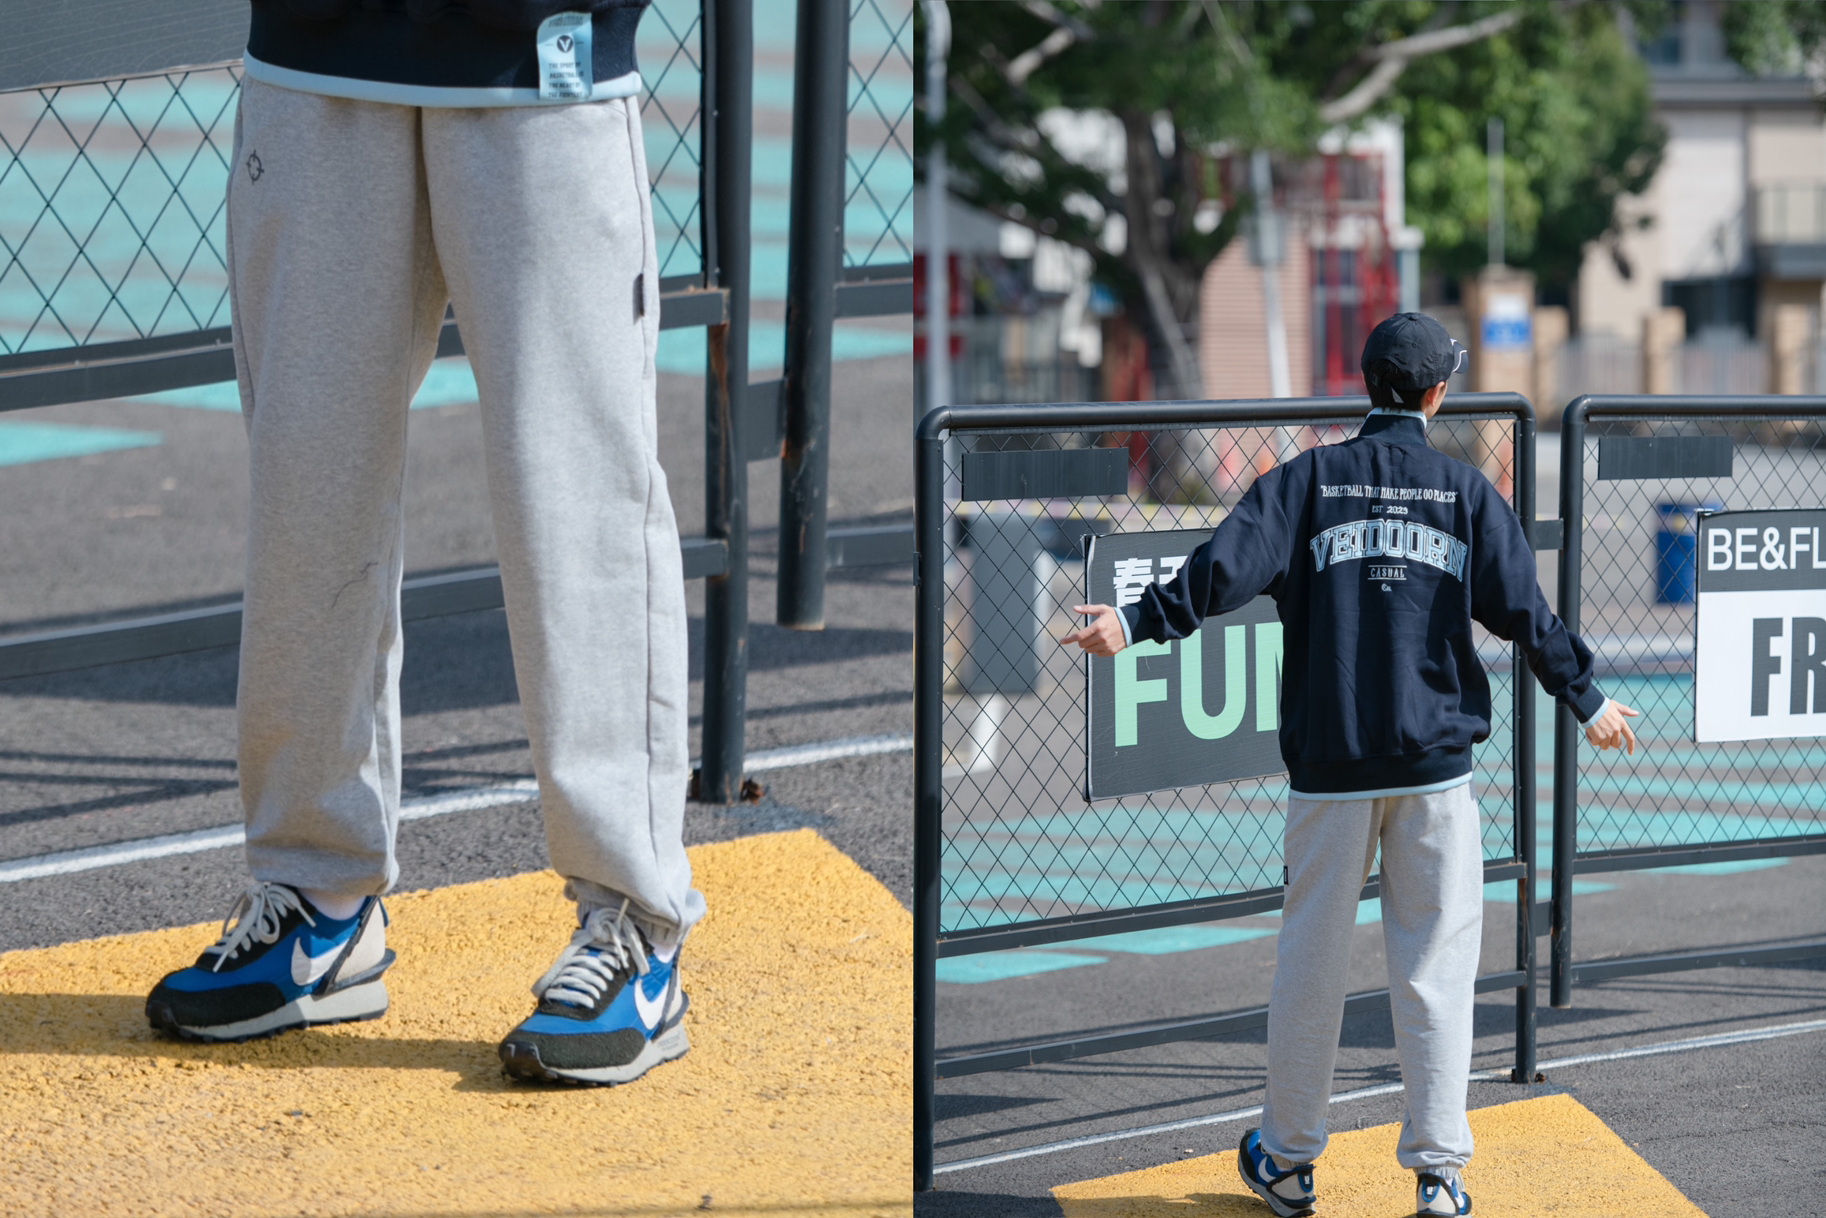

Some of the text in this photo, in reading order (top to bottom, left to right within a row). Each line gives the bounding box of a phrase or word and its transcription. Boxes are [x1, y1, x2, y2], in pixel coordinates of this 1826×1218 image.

[1381, 486, 1399, 500] MAKE
[1400, 488, 1423, 501] PEOPLE
[1310, 518, 1468, 583] VEIDOORN
[1370, 567, 1405, 579] CASUAL
